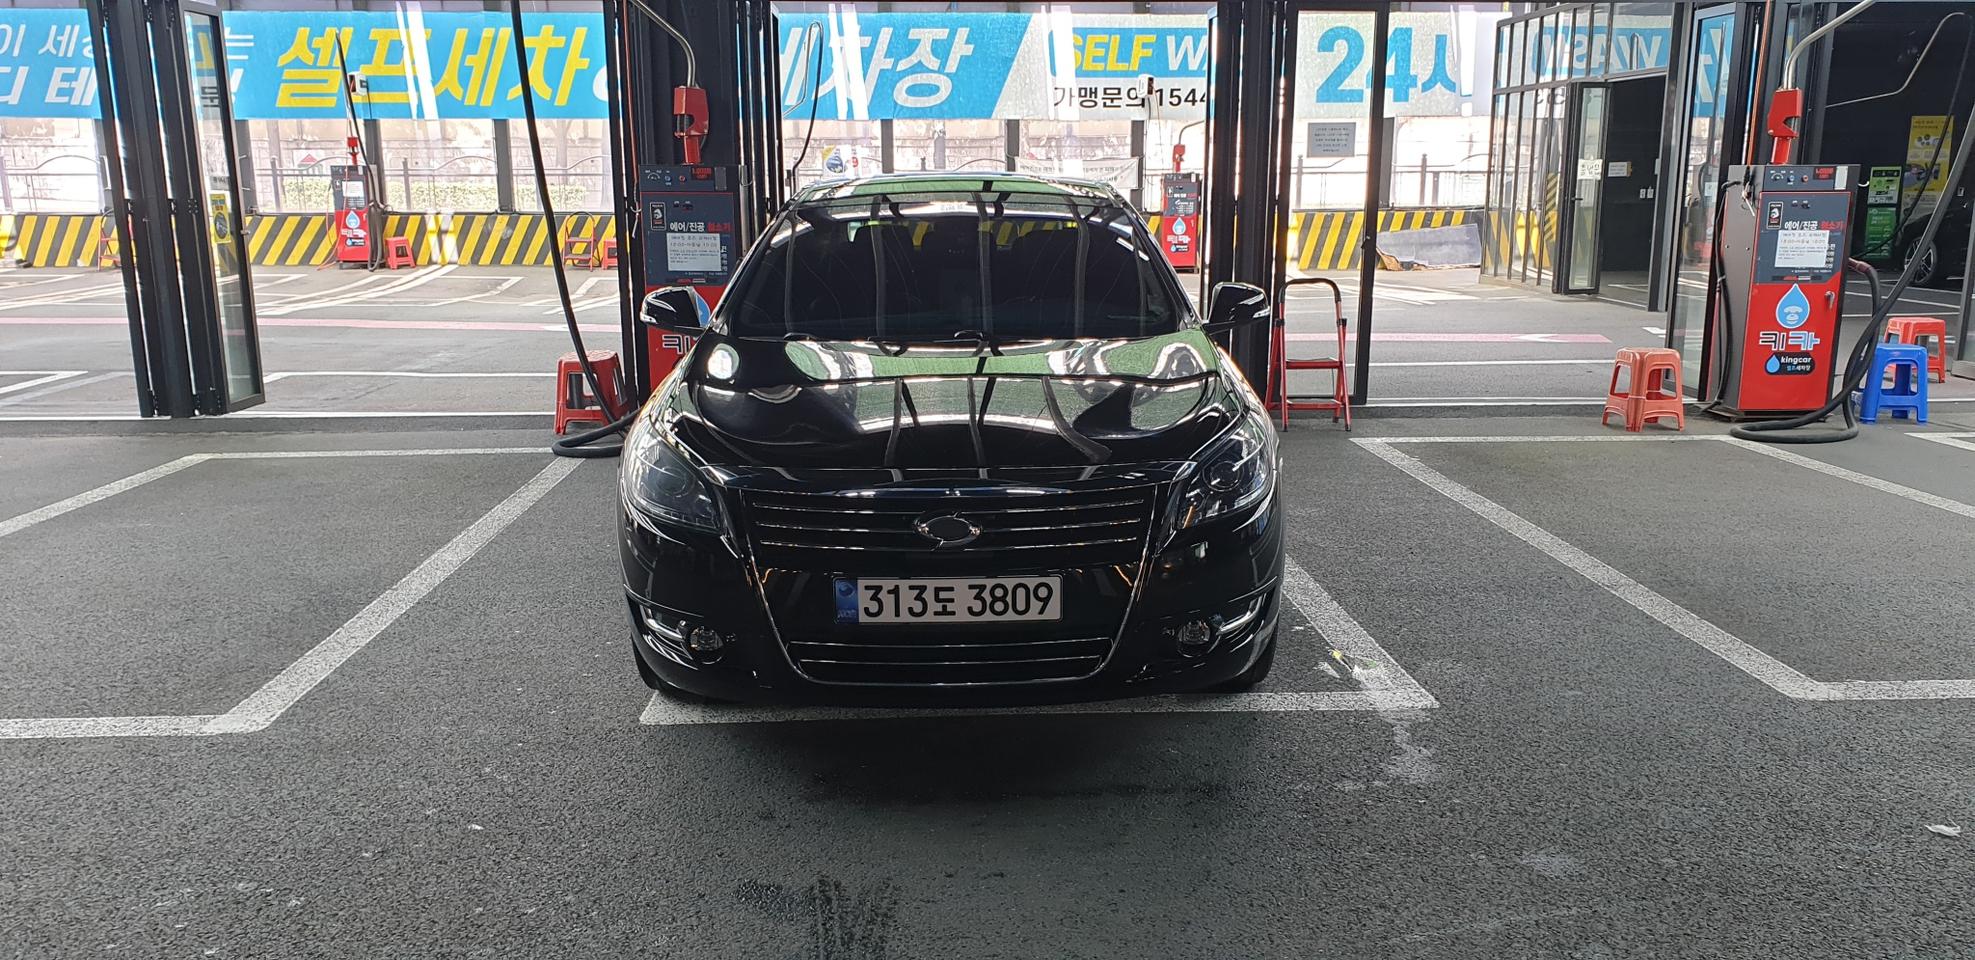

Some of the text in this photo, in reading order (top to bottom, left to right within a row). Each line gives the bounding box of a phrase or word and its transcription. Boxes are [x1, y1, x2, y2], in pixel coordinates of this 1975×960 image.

[1167, 35, 1207, 71] W
[1054, 86, 1145, 109] 가맹문의
[1759, 331, 1820, 351] 키카
[1781, 356, 1812, 364] kingcar
[863, 582, 1053, 618] 313도 3809
